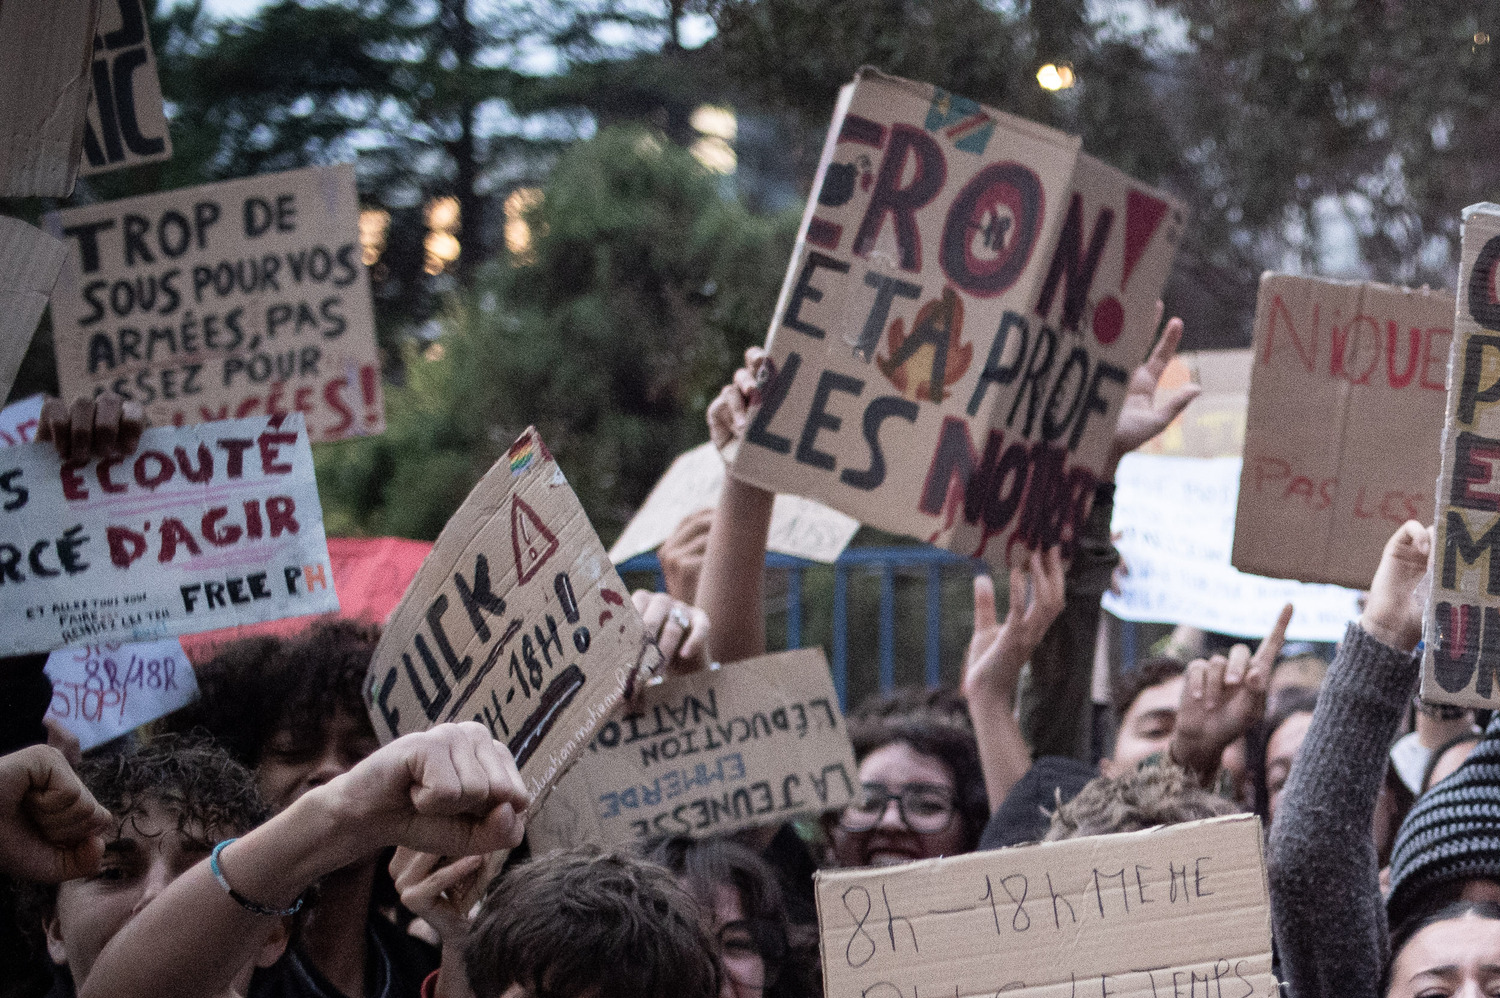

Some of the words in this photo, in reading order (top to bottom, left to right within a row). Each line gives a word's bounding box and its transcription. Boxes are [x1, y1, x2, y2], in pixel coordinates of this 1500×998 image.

[62, 201, 221, 274] TROP
[243, 194, 297, 238] DE
[78, 269, 181, 327] SOUS
[193, 254, 281, 303] POUR
[286, 246, 359, 289] VOS
[88, 306, 261, 375] ARMÉES,
[266, 297, 347, 341] PAS
[93, 364, 204, 403] SSEZ
[222, 346, 321, 387] POUR
[967, 312, 1128, 451] PROF
[746, 352, 920, 492] LES
[106, 495, 300, 570] D'AGIR
[179, 571, 272, 614] FREE
[378, 553, 507, 738] FUCK
[600, 752, 747, 819] EMMERDE
[630, 773, 804, 838] JEUNESSE
[809, 762, 856, 802] LA
